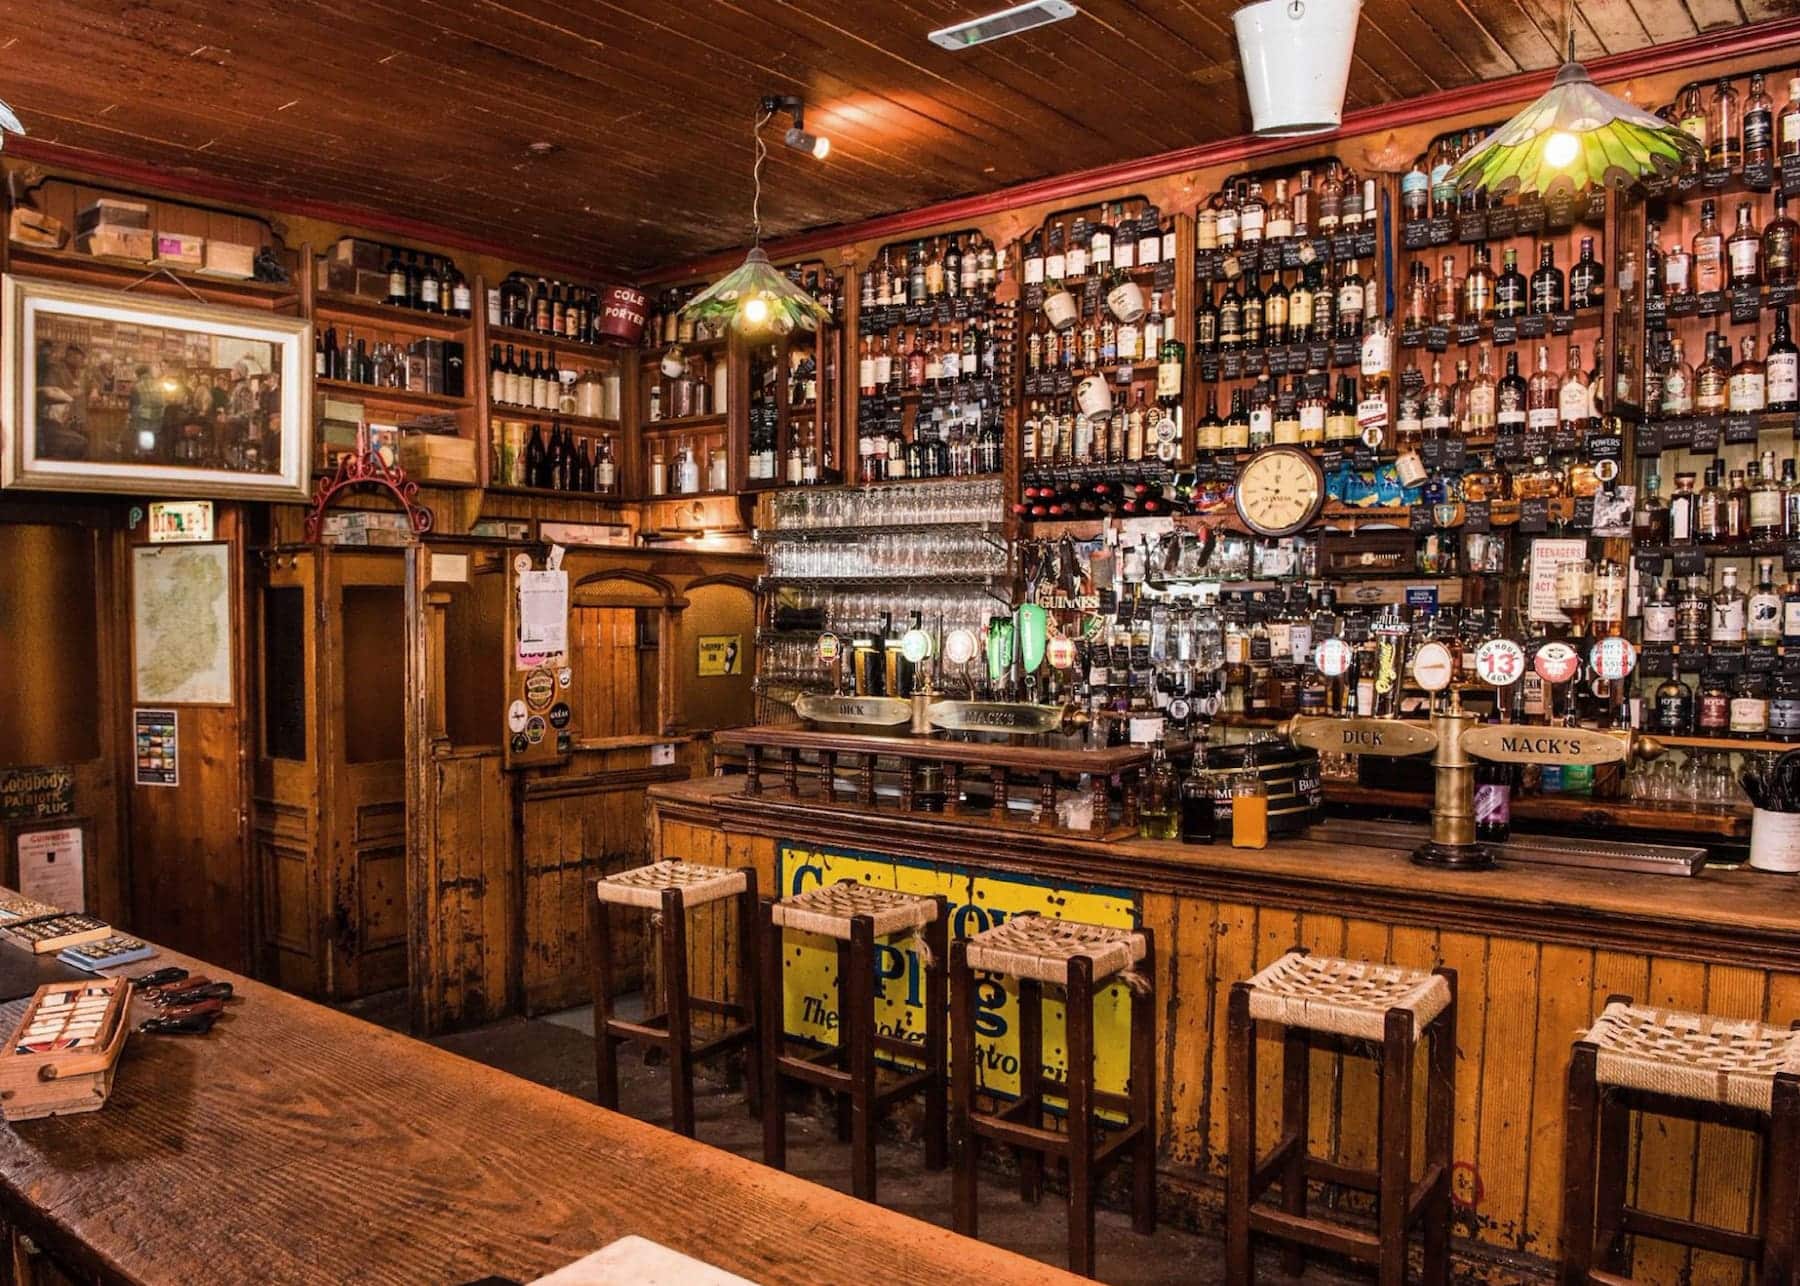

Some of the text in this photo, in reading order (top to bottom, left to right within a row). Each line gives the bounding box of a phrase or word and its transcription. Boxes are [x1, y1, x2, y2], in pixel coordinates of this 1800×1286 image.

[614, 289, 645, 307] COLE
[605, 306, 645, 326] PORTER
[1591, 438, 1621, 449] POWERS
[1486, 653, 1515, 673] 13
[840, 703, 1016, 726] DICK MACK'S
[1342, 730, 1581, 755] DICK MACK'S
[803, 996, 839, 1030] The
